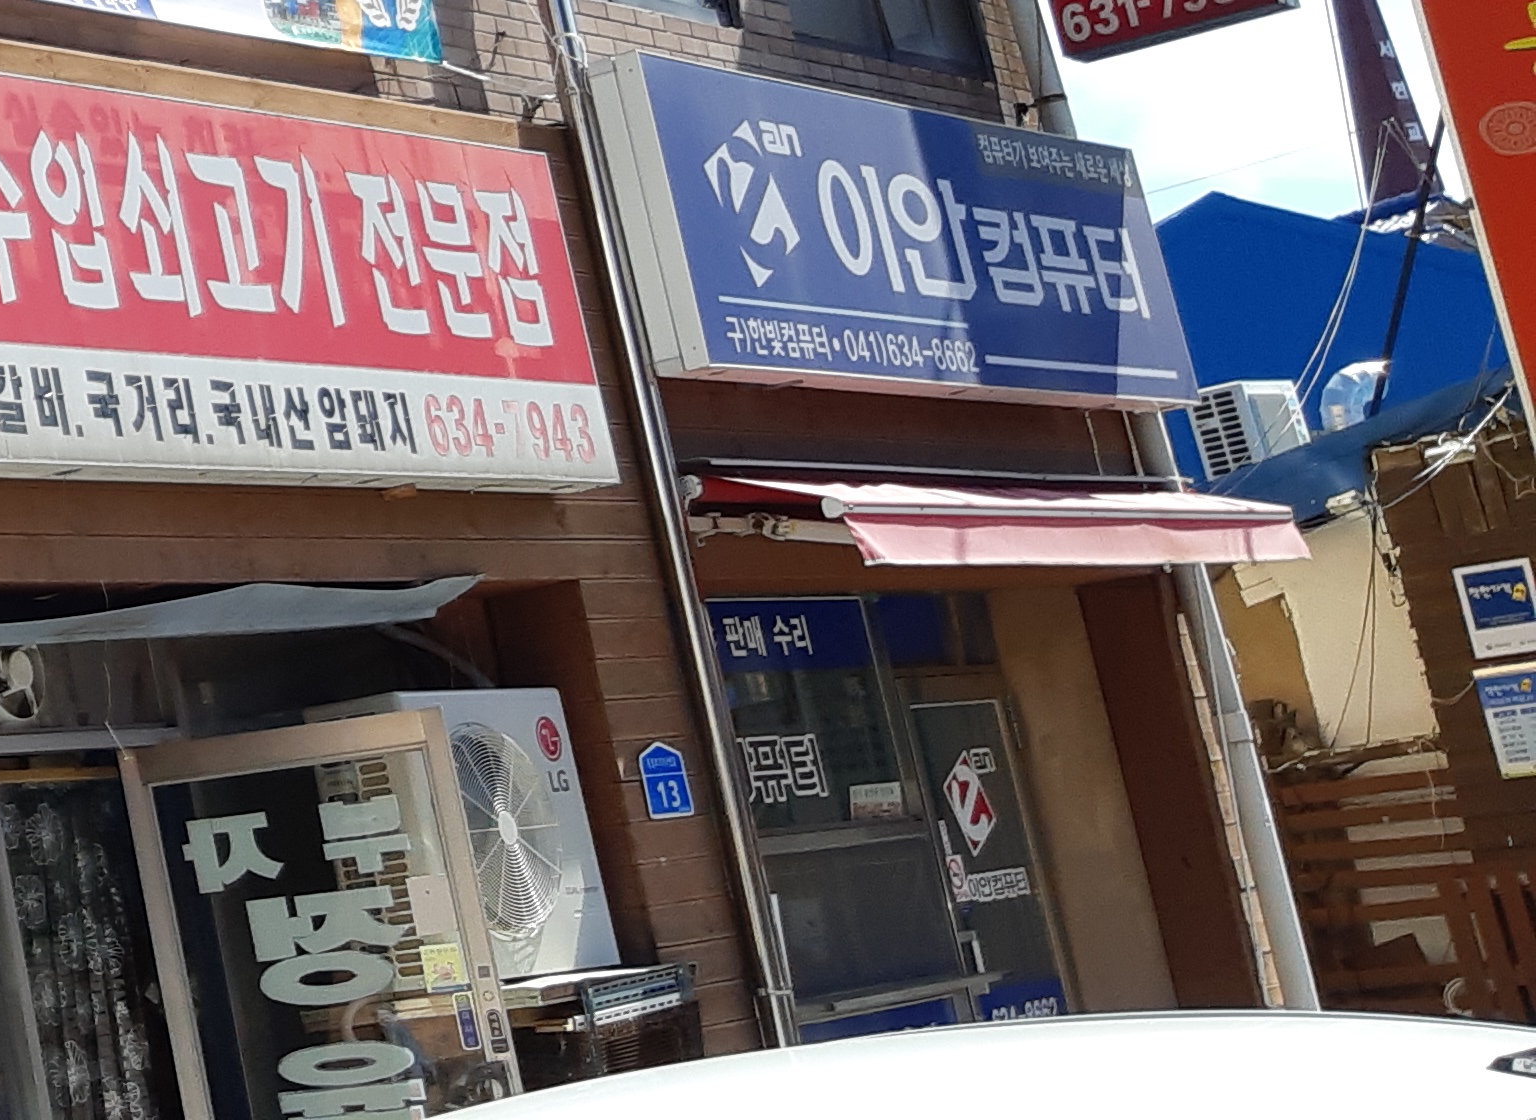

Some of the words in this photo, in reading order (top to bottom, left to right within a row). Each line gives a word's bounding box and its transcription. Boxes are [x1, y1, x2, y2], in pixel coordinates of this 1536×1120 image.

[343, 168, 557, 349] 전문점
[722, 615, 768, 657] 판매
[772, 614, 814, 655] 수리
[547, 769, 571, 793] LG
[736, 733, 830, 804] 퓨터
[656, 779, 682, 810] 13
